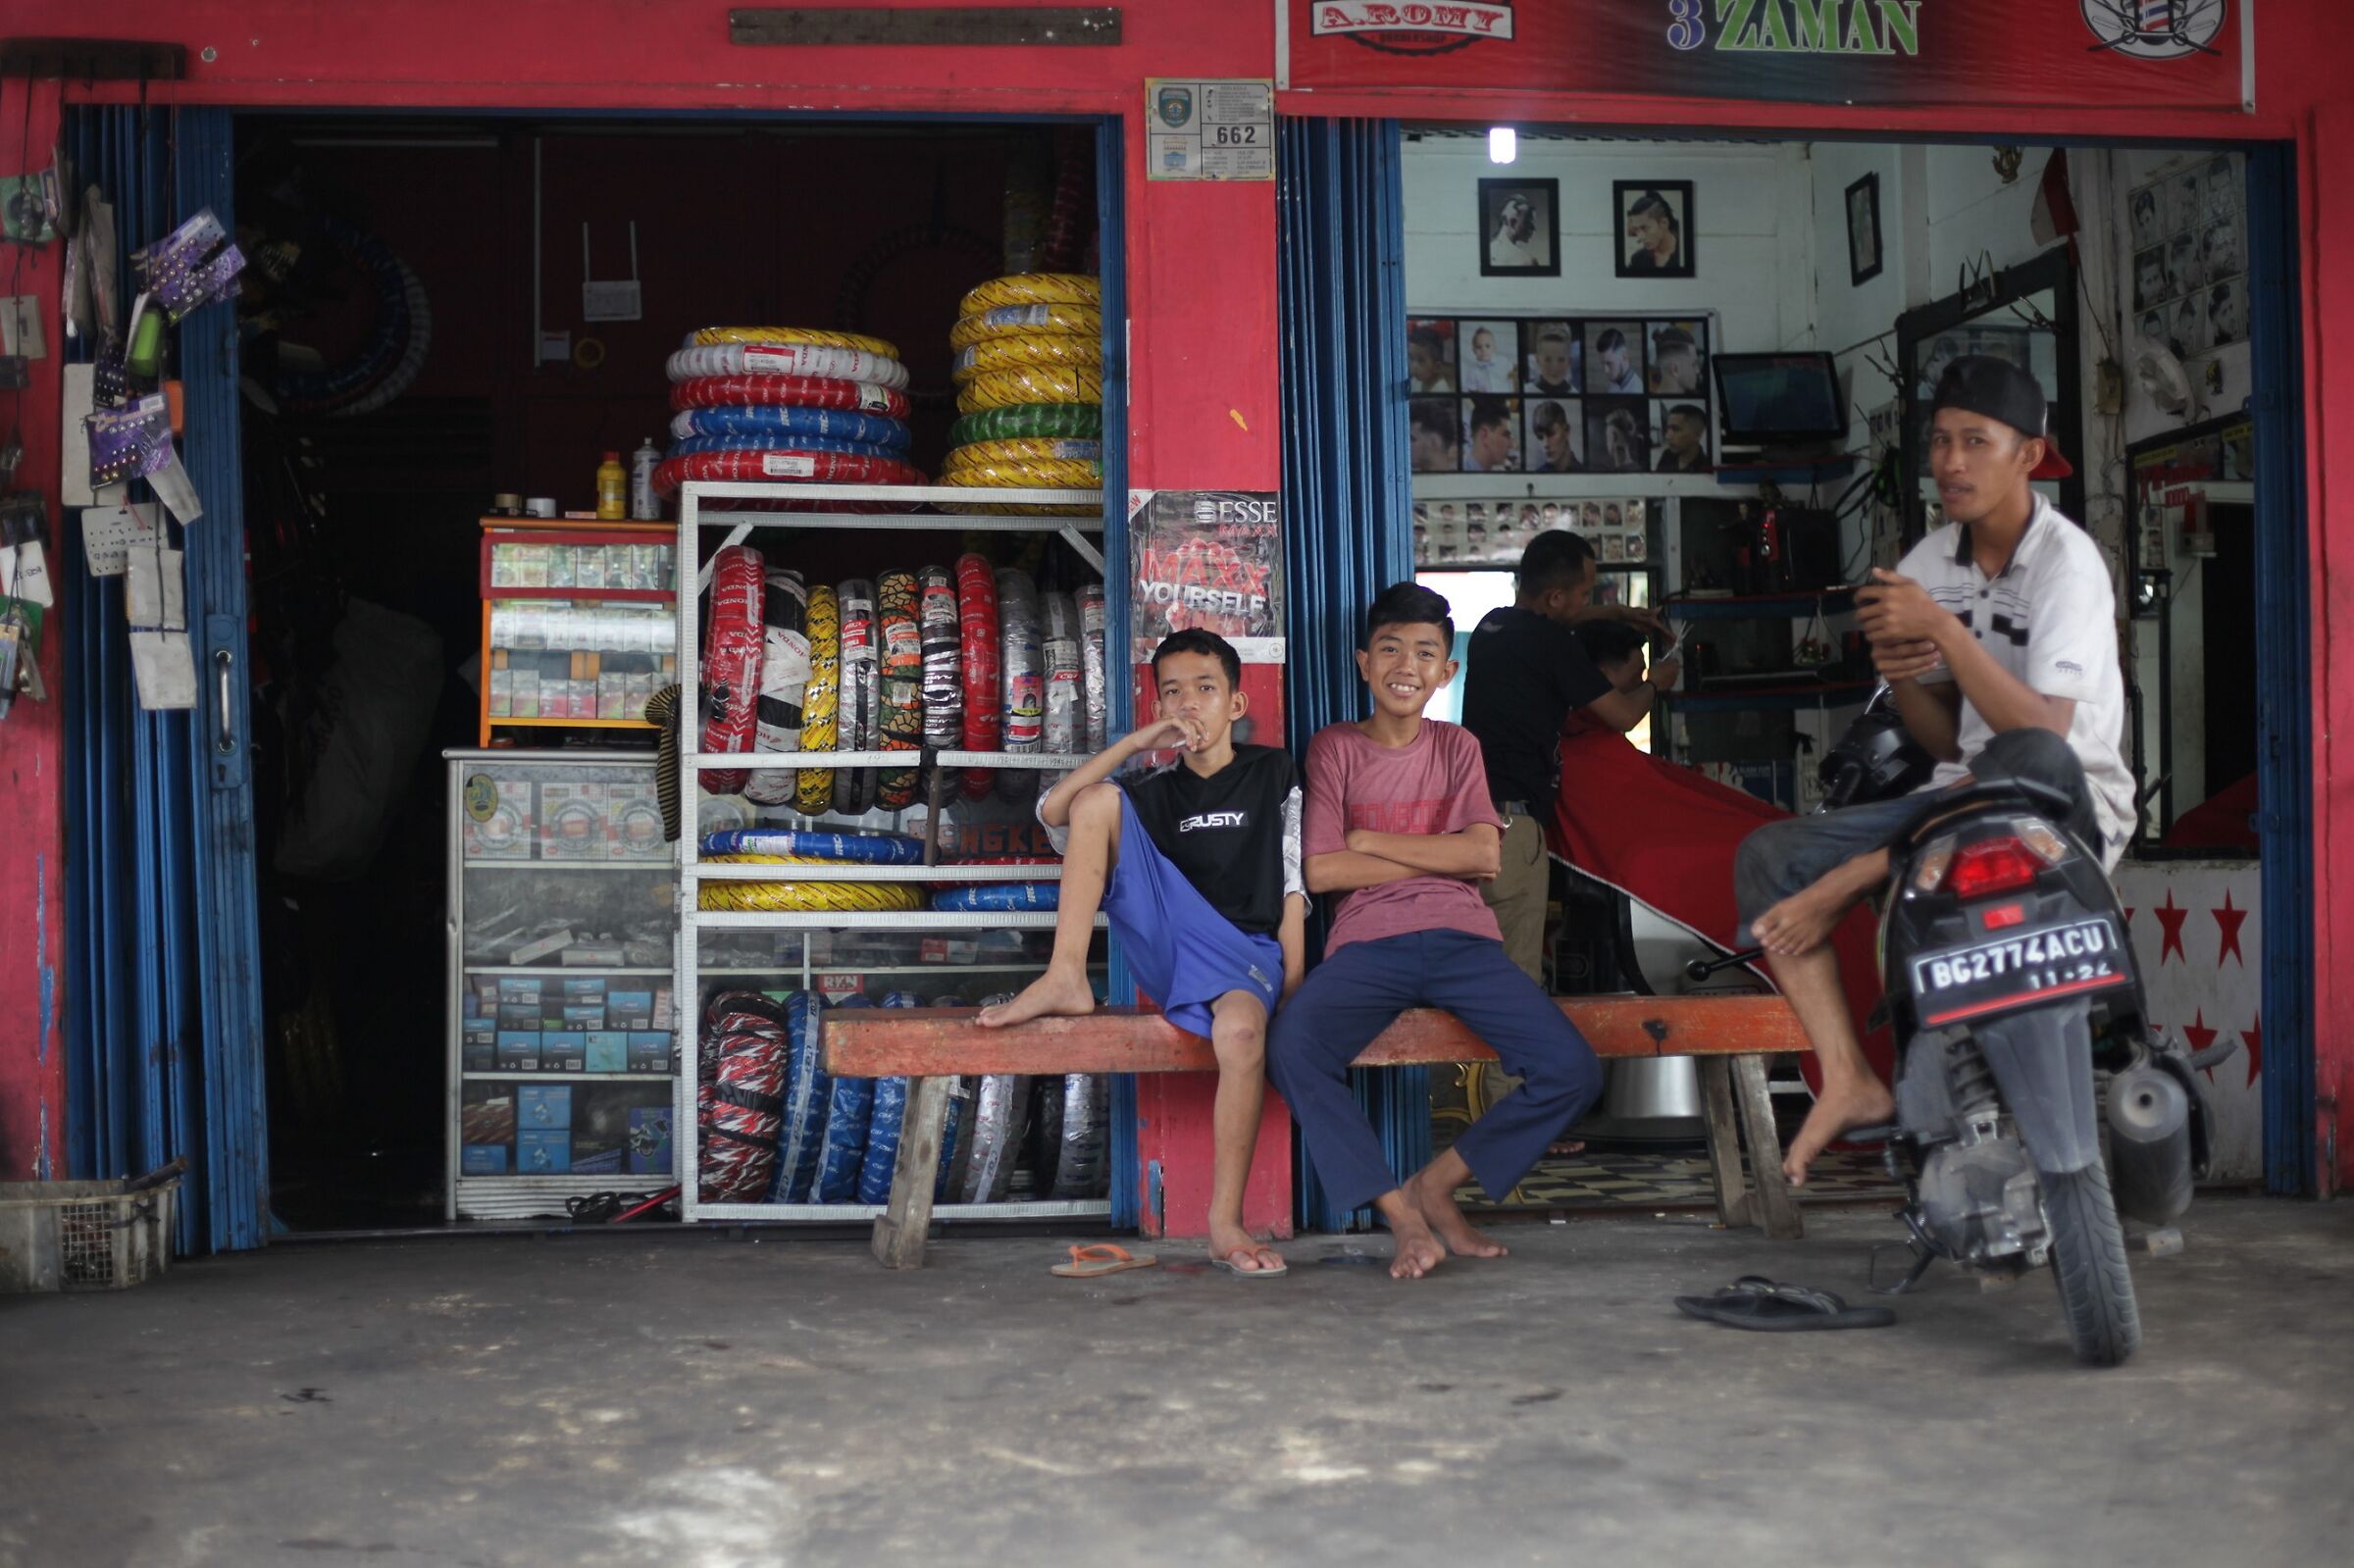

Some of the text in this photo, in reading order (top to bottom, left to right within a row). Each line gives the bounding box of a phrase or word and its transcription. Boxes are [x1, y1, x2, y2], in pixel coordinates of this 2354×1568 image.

[1714, 0, 1921, 55] ZAMAN
[1217, 126, 1256, 144] 662
[1219, 501, 1278, 524] ESSE
[1139, 580, 1266, 618] YOURSELF
